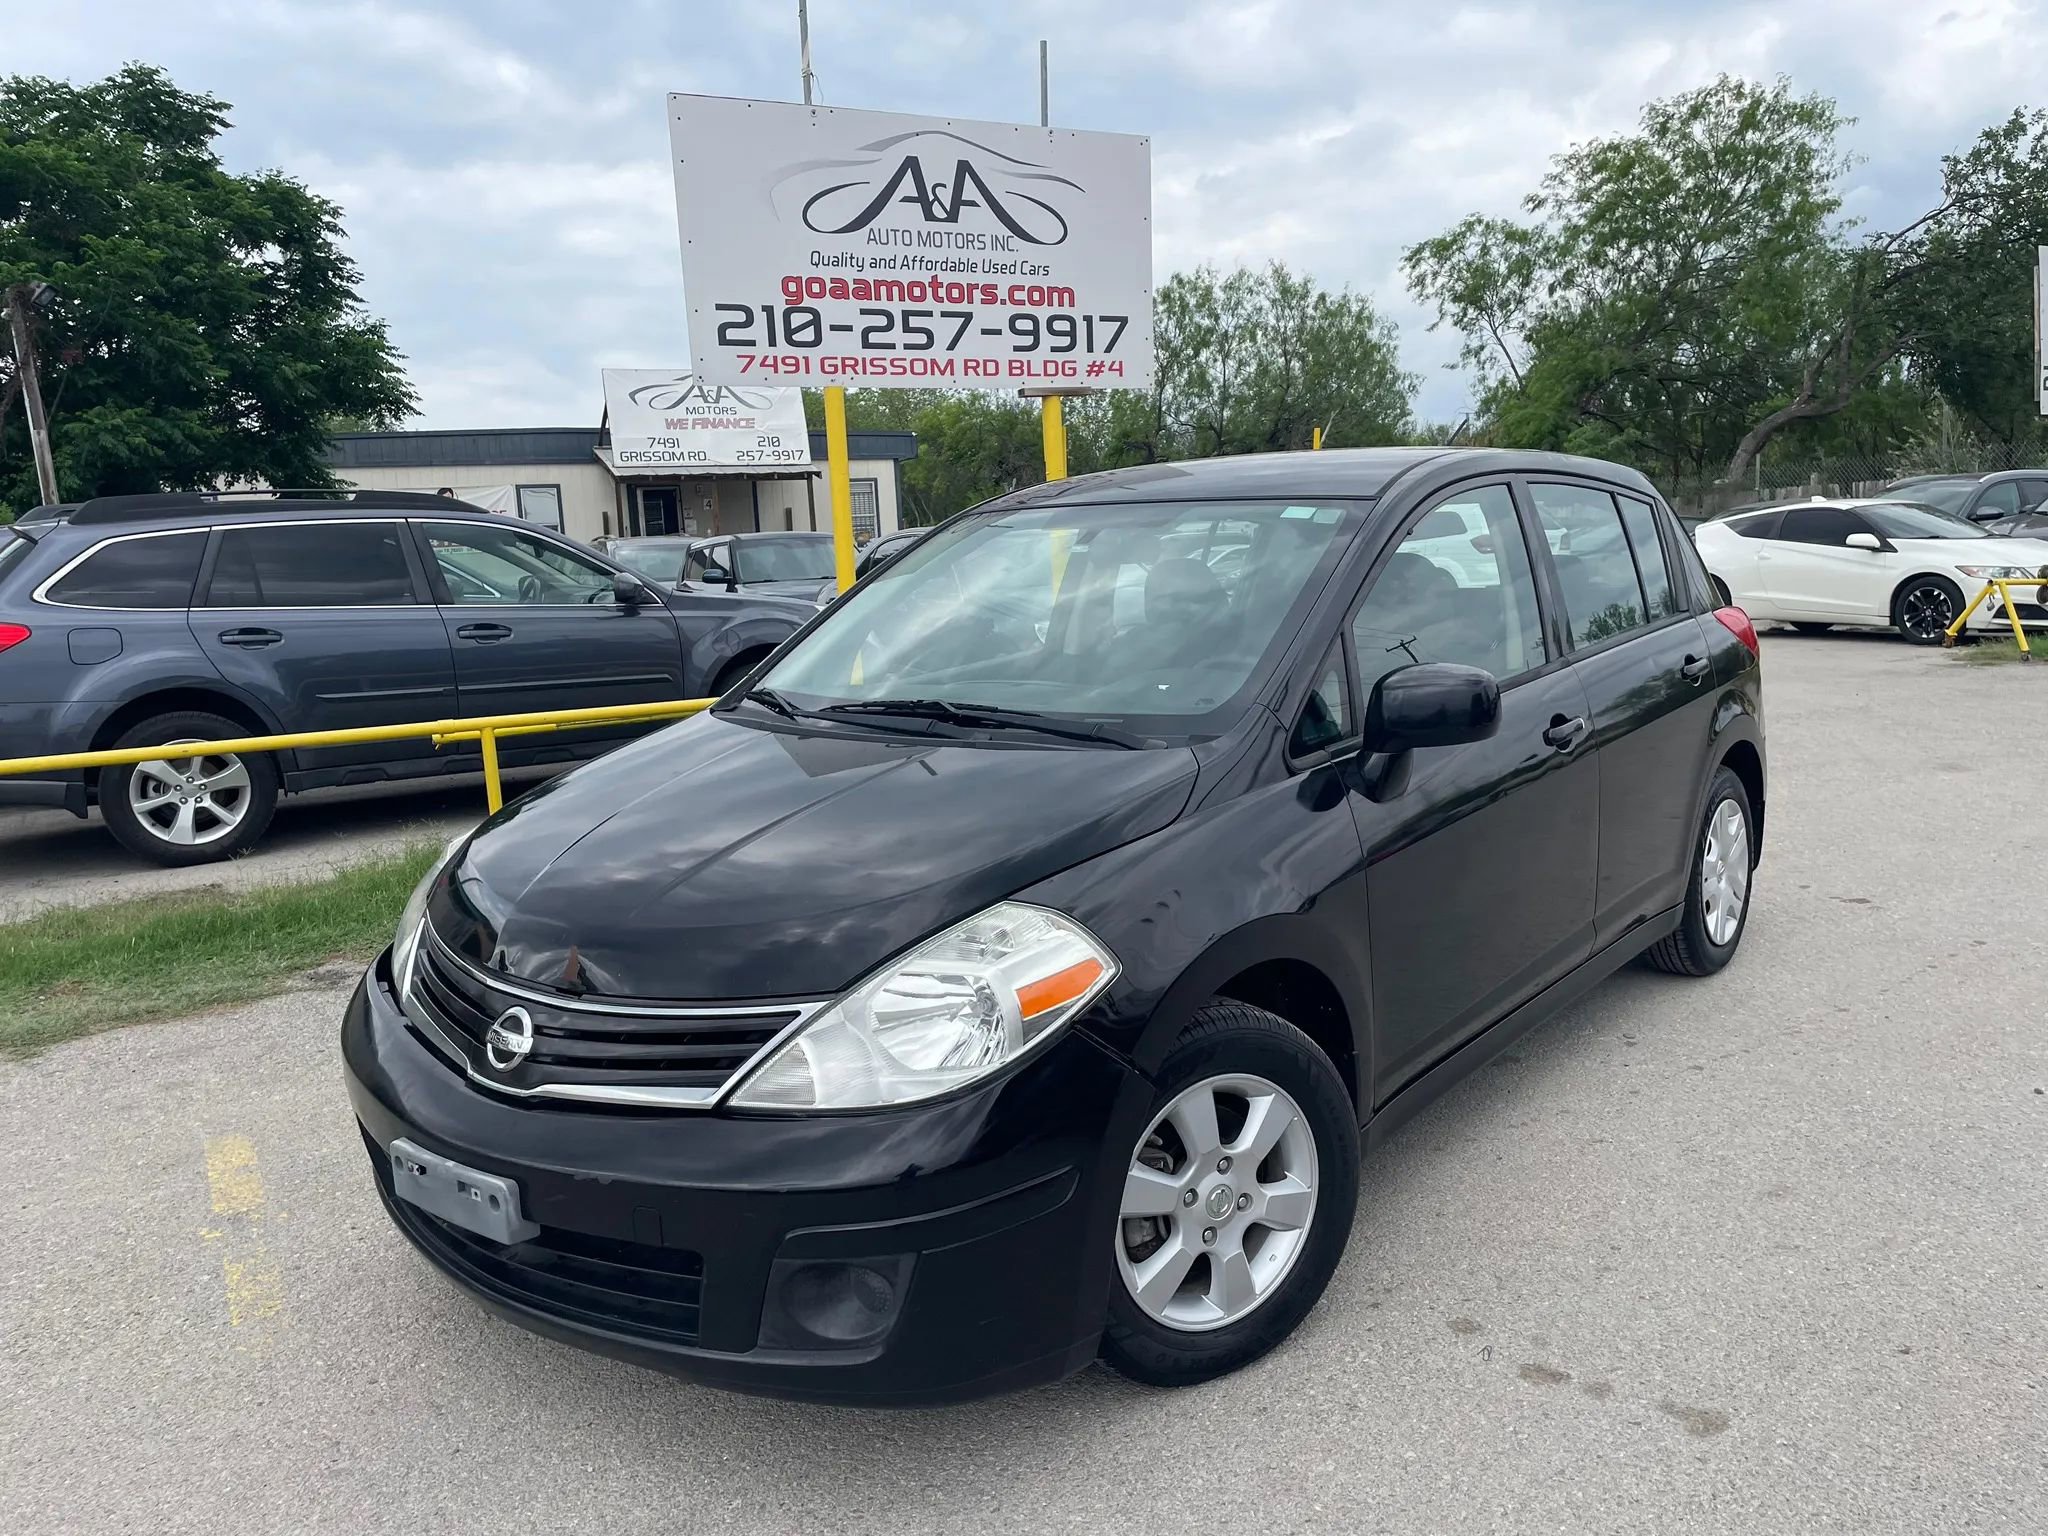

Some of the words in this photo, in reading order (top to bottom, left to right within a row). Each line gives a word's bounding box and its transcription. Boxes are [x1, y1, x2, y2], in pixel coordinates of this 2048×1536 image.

[832, 155, 1050, 245] A&A
[866, 228, 912, 247] AUTO
[917, 231, 986, 250] MOTORS
[991, 235, 1019, 252] INC.
[810, 251, 865, 272] Quality
[870, 254, 896, 270] and
[900, 255, 978, 273] Affordable
[982, 259, 1017, 275] Used
[1021, 261, 1050, 276] Cars
[781, 274, 1076, 307] goaamotors.com
[715, 303, 1129, 353] 210-257-9917
[736, 354, 810, 374] 7491
[820, 356, 955, 376] GRISSOM
[963, 359, 1000, 377] RD
[1008, 359, 1077, 377] BLDG
[1086, 360, 1124, 377] #4
[685, 406, 737, 416] MOTORS
[664, 418, 689, 430] WE
[691, 417, 755, 430] FINANCE
[647, 437, 680, 449] 7491
[757, 436, 781, 447] 210
[620, 451, 685, 462] GRISSOM
[736, 450, 804, 461] 257-9917
